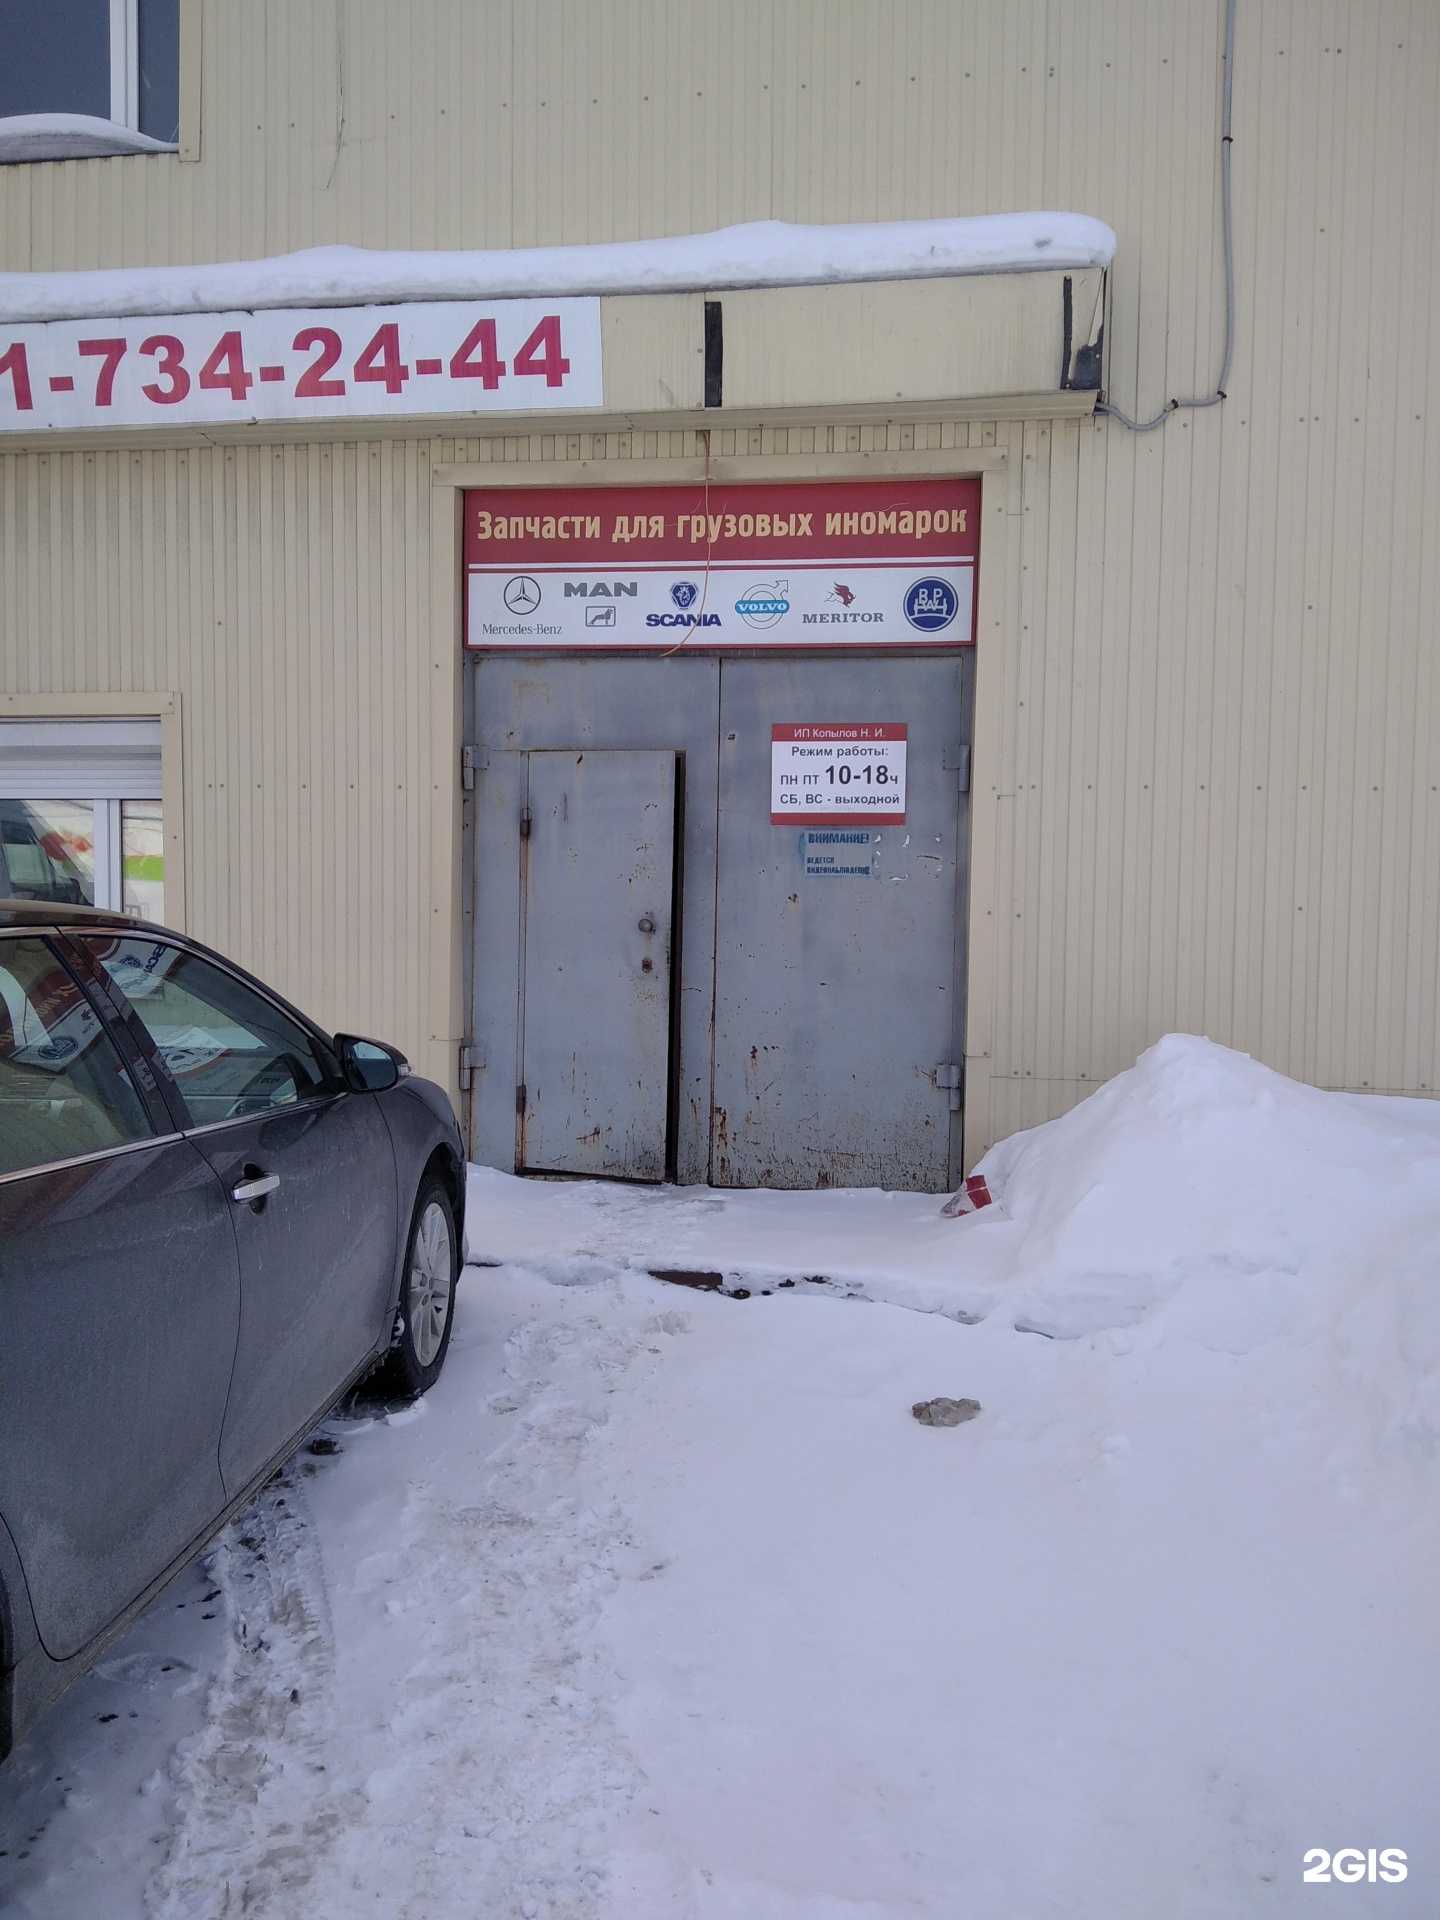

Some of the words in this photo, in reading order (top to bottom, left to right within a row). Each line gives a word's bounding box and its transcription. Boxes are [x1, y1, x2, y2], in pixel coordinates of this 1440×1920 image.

[0, 315, 570, 411] 1-734-24-44
[477, 511, 601, 540] Запчасти
[611, 515, 664, 543] для
[677, 513, 813, 543] грузовых
[825, 509, 967, 539] иномарок
[563, 582, 638, 597] MAN
[738, 603, 787, 612] VOLVO
[645, 613, 722, 627] SCANIA
[802, 612, 884, 624] MERITOR
[482, 624, 562, 636] Mercedes-Benz
[794, 729, 810, 738] ИП
[812, 729, 857, 738] Копылов
[860, 728, 871, 737] Н.
[874, 728, 886, 737] И.
[791, 746, 833, 757] Режим
[836, 746, 889, 758] работы:
[780, 793, 801, 805] СБ,
[805, 793, 823, 804] ВС
[834, 794, 900, 805] выходной
